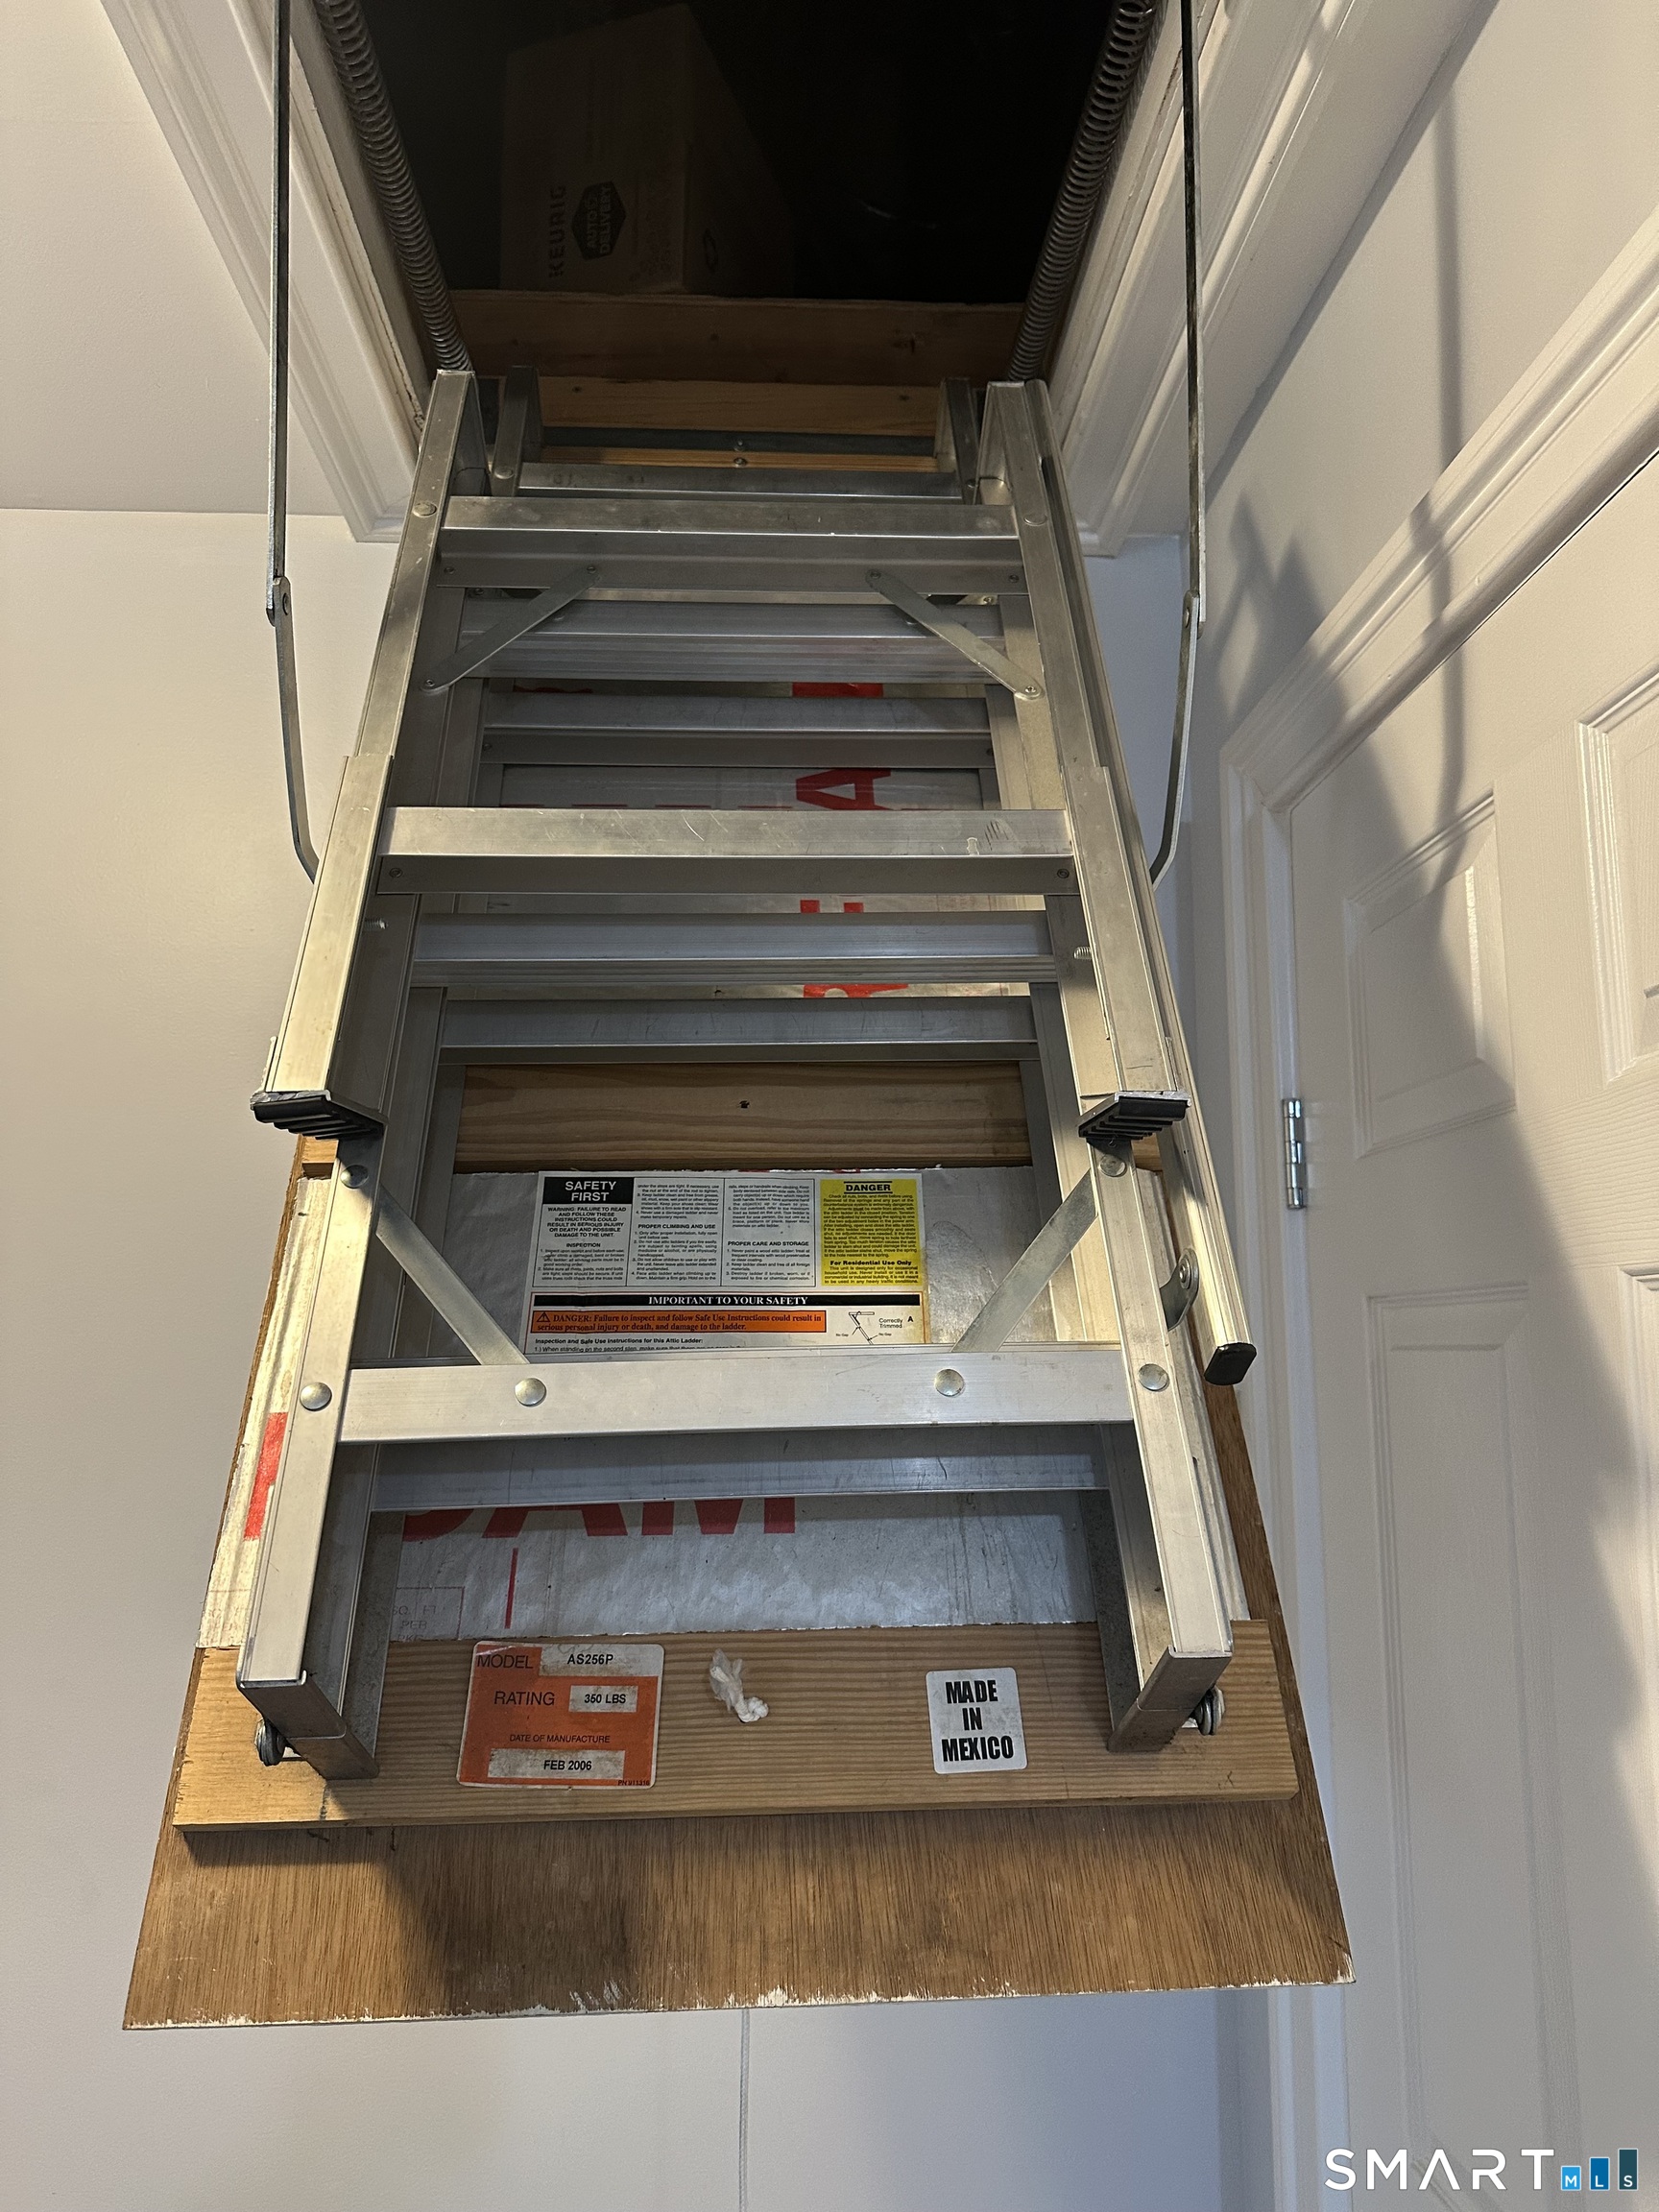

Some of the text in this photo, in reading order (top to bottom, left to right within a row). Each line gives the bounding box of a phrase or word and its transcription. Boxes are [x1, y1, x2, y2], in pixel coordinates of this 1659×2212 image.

[598, 185, 613, 255] DELIVERY
[548, 185, 566, 278] KEURIG
[565, 1181, 616, 1190] SAFETY
[571, 1192, 609, 1201] FIRST
[649, 1296, 808, 1305] IMPORTANT TO YOUR SAFETY
[630, 1314, 655, 1324] inspect
[565, 1324, 595, 1333] personal
[477, 1654, 613, 1669] MODEL AS256P
[946, 1680, 998, 1703] MADE
[493, 1691, 626, 1705] RATING 350 LBS
[962, 1707, 982, 1730] IN
[510, 1734, 531, 1743] DATE
[533, 1734, 544, 1743] OF
[942, 1736, 1014, 1762] MEXICO
[544, 1760, 591, 1770] FEB 2006
